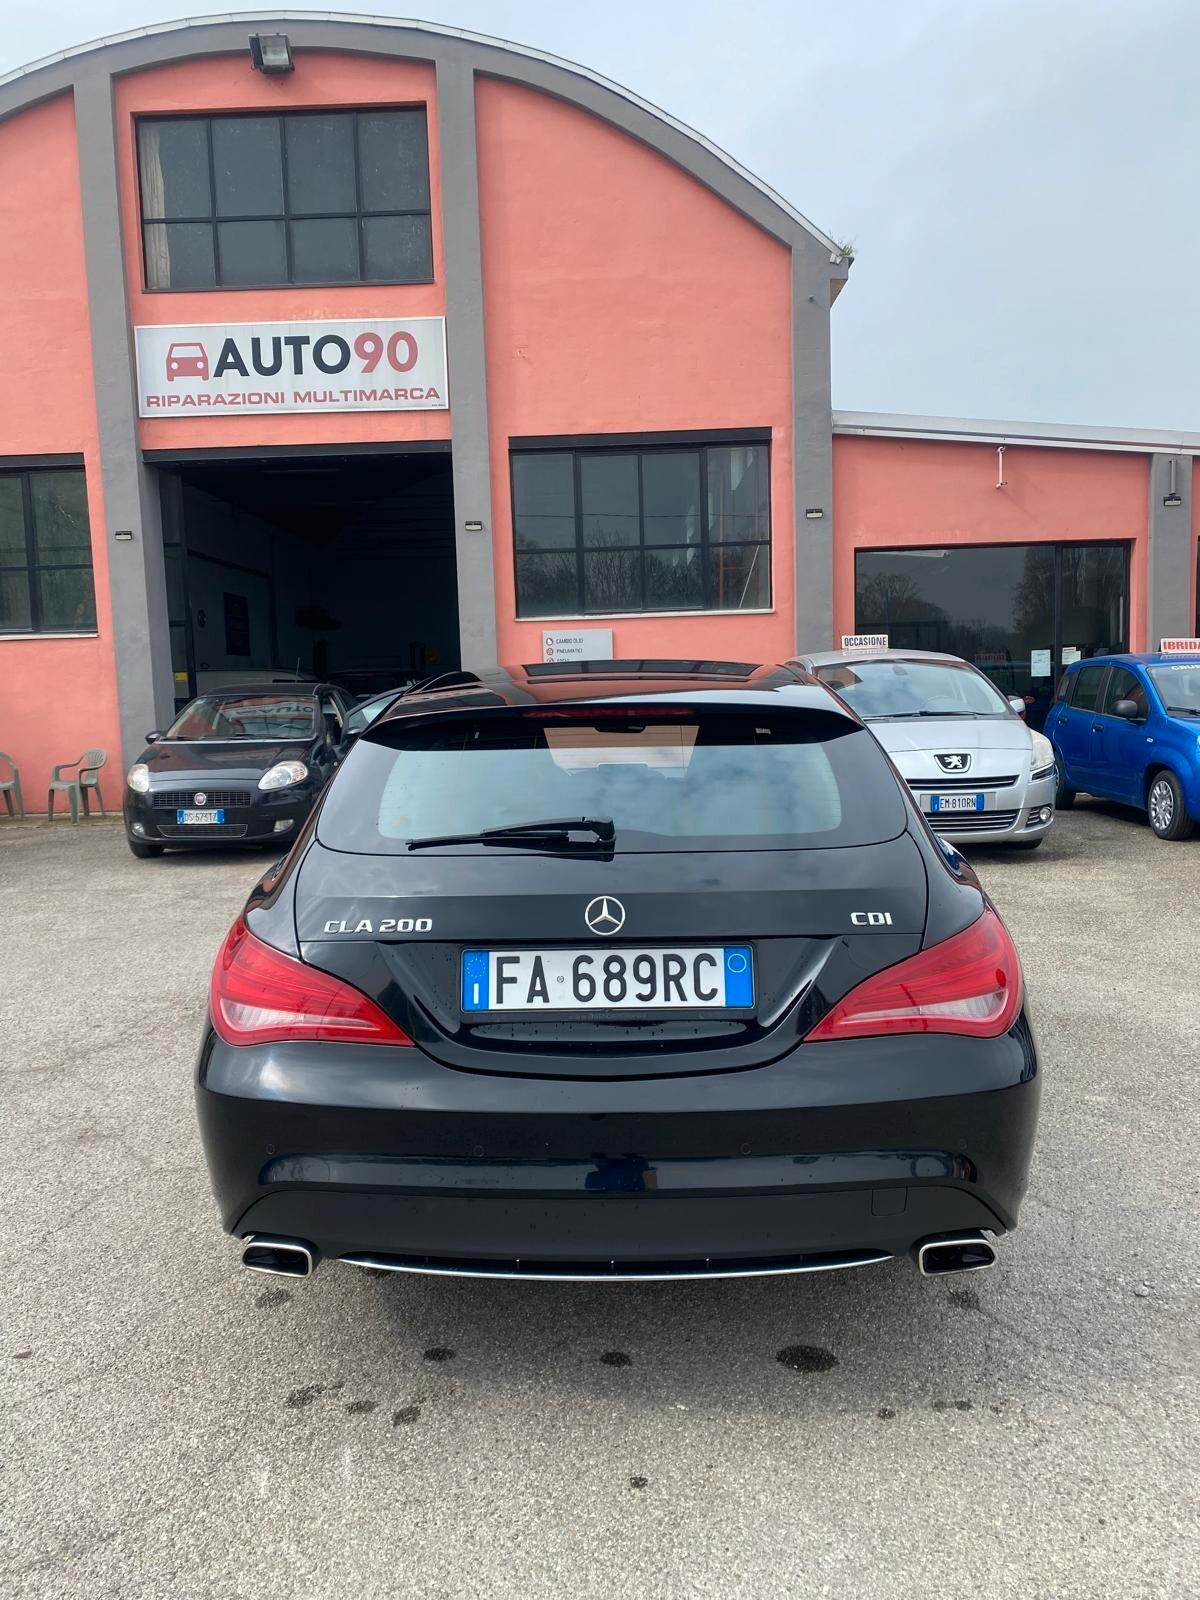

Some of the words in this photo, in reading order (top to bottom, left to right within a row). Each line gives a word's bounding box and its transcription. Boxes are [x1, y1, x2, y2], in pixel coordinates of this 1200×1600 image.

[213, 331, 419, 378] AUTO90
[146, 391, 285, 408] RIPARAZIONI
[293, 387, 440, 405] MULTIMARCA
[844, 637, 887, 647] OCCASIONE
[951, 797, 976, 808] 810RN
[324, 920, 373, 934] CLA
[379, 919, 433, 933] 200
[850, 912, 893, 926] CDI
[496, 955, 550, 1004] FA
[572, 953, 719, 1002] 689RC
